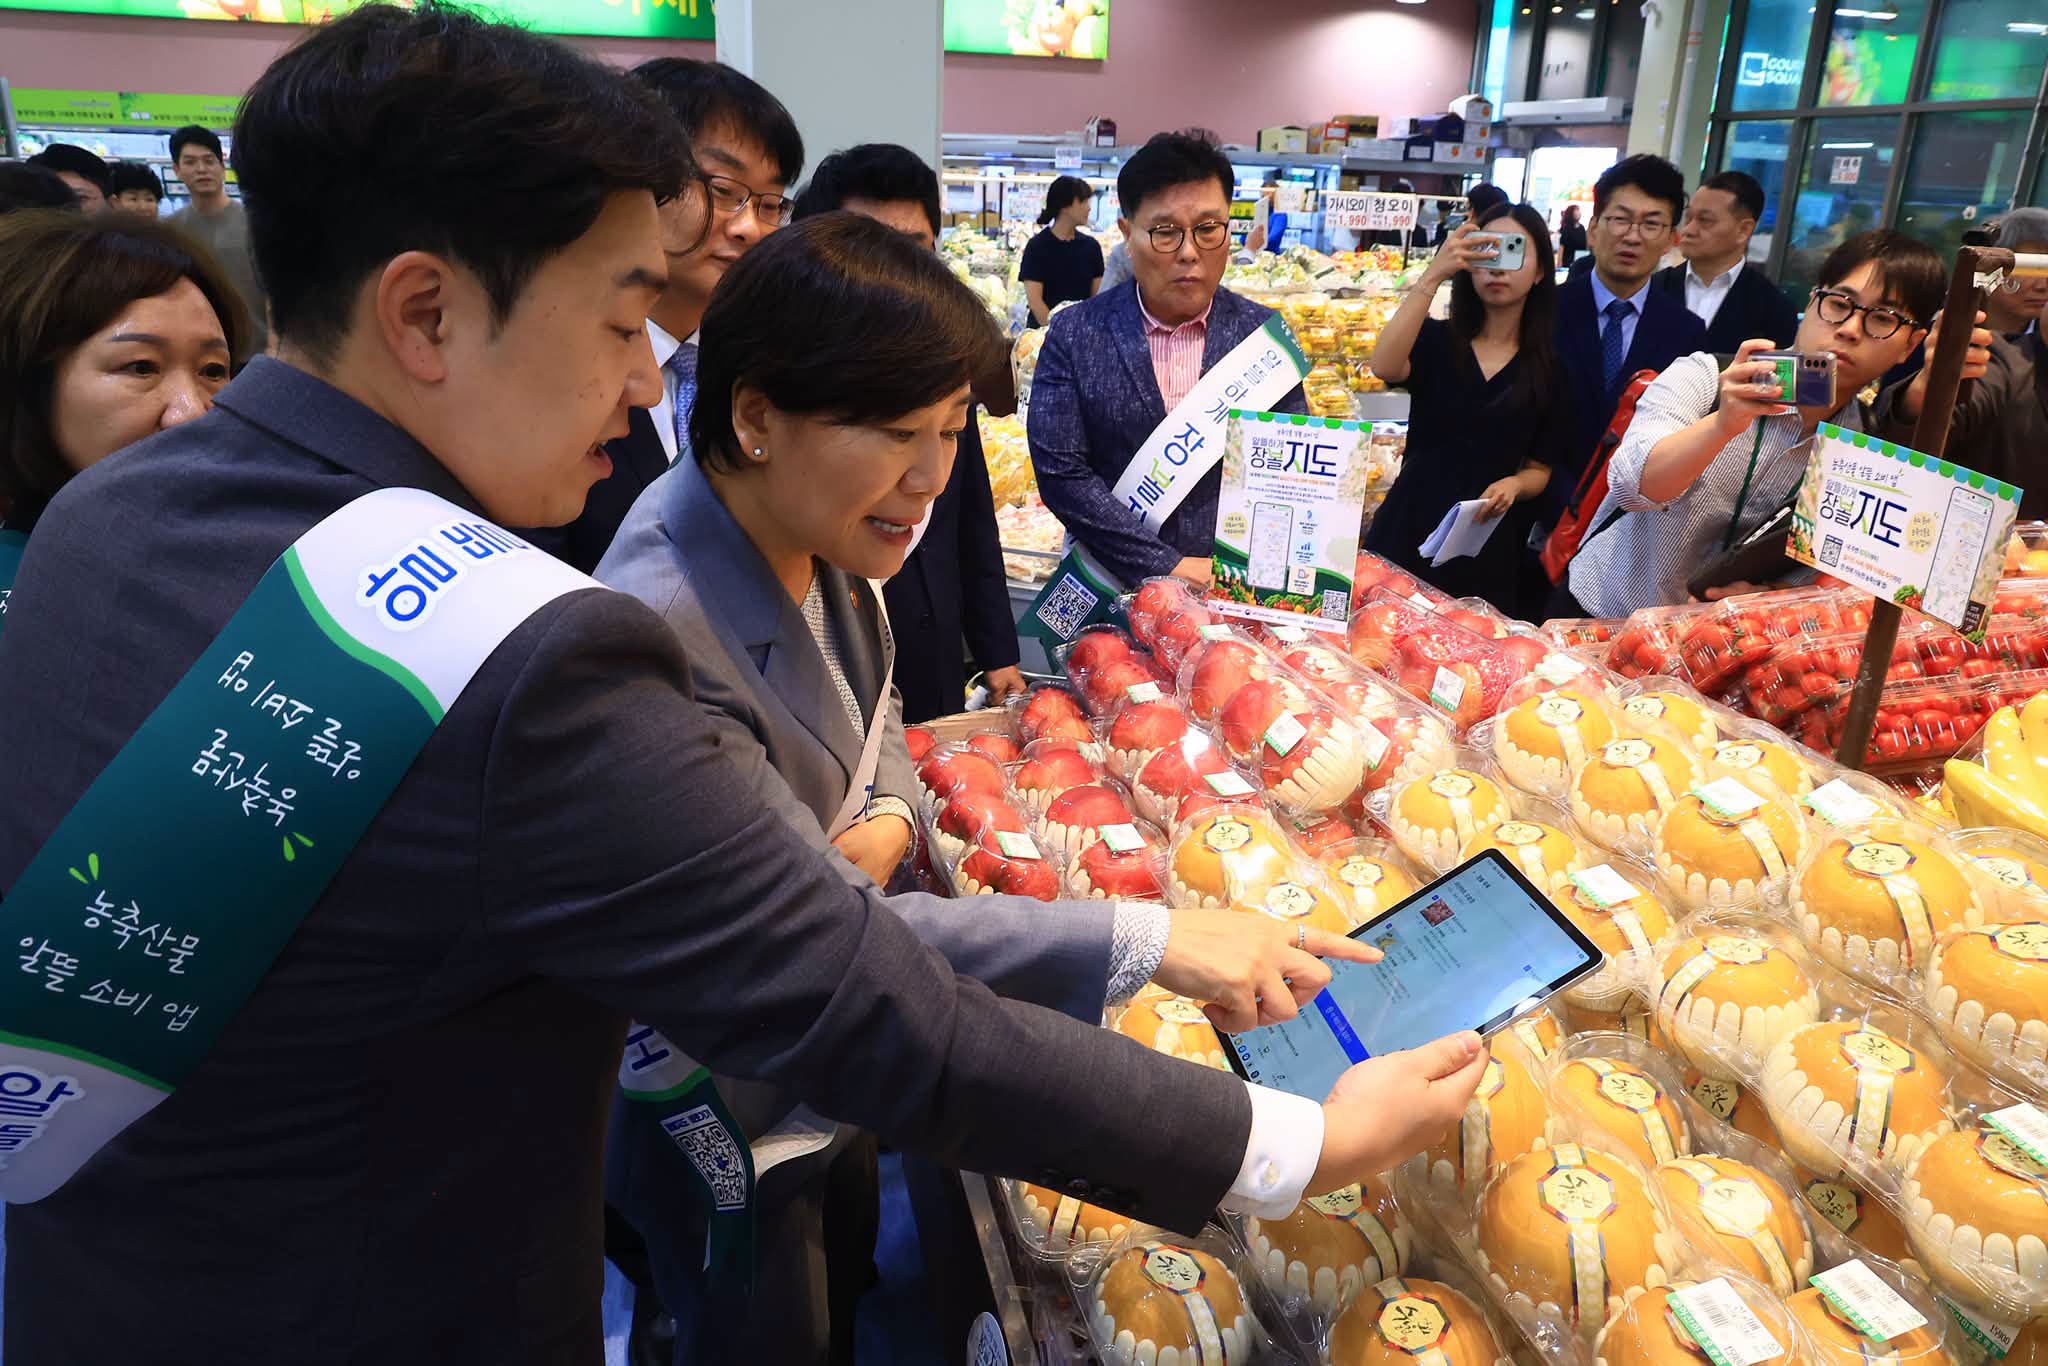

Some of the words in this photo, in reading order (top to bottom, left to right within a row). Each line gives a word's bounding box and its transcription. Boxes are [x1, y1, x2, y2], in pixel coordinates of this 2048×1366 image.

[1329, 197, 1368, 213] 가시오이
[1339, 215, 1367, 226] 1,990
[1384, 215, 1410, 226] 1,990
[1252, 436, 1285, 449] 알뜰하게
[1825, 479, 1858, 499] 알뜰하게
[218, 650, 255, 692] 앱
[251, 680, 314, 730] 소비
[306, 717, 361, 779] 알뜰
[192, 728, 297, 827] 농축산물
[84, 889, 200, 975] 농축산물
[19, 936, 80, 993] 알뜰
[79, 978, 153, 1016] 소비
[162, 1002, 200, 1032] 앱
